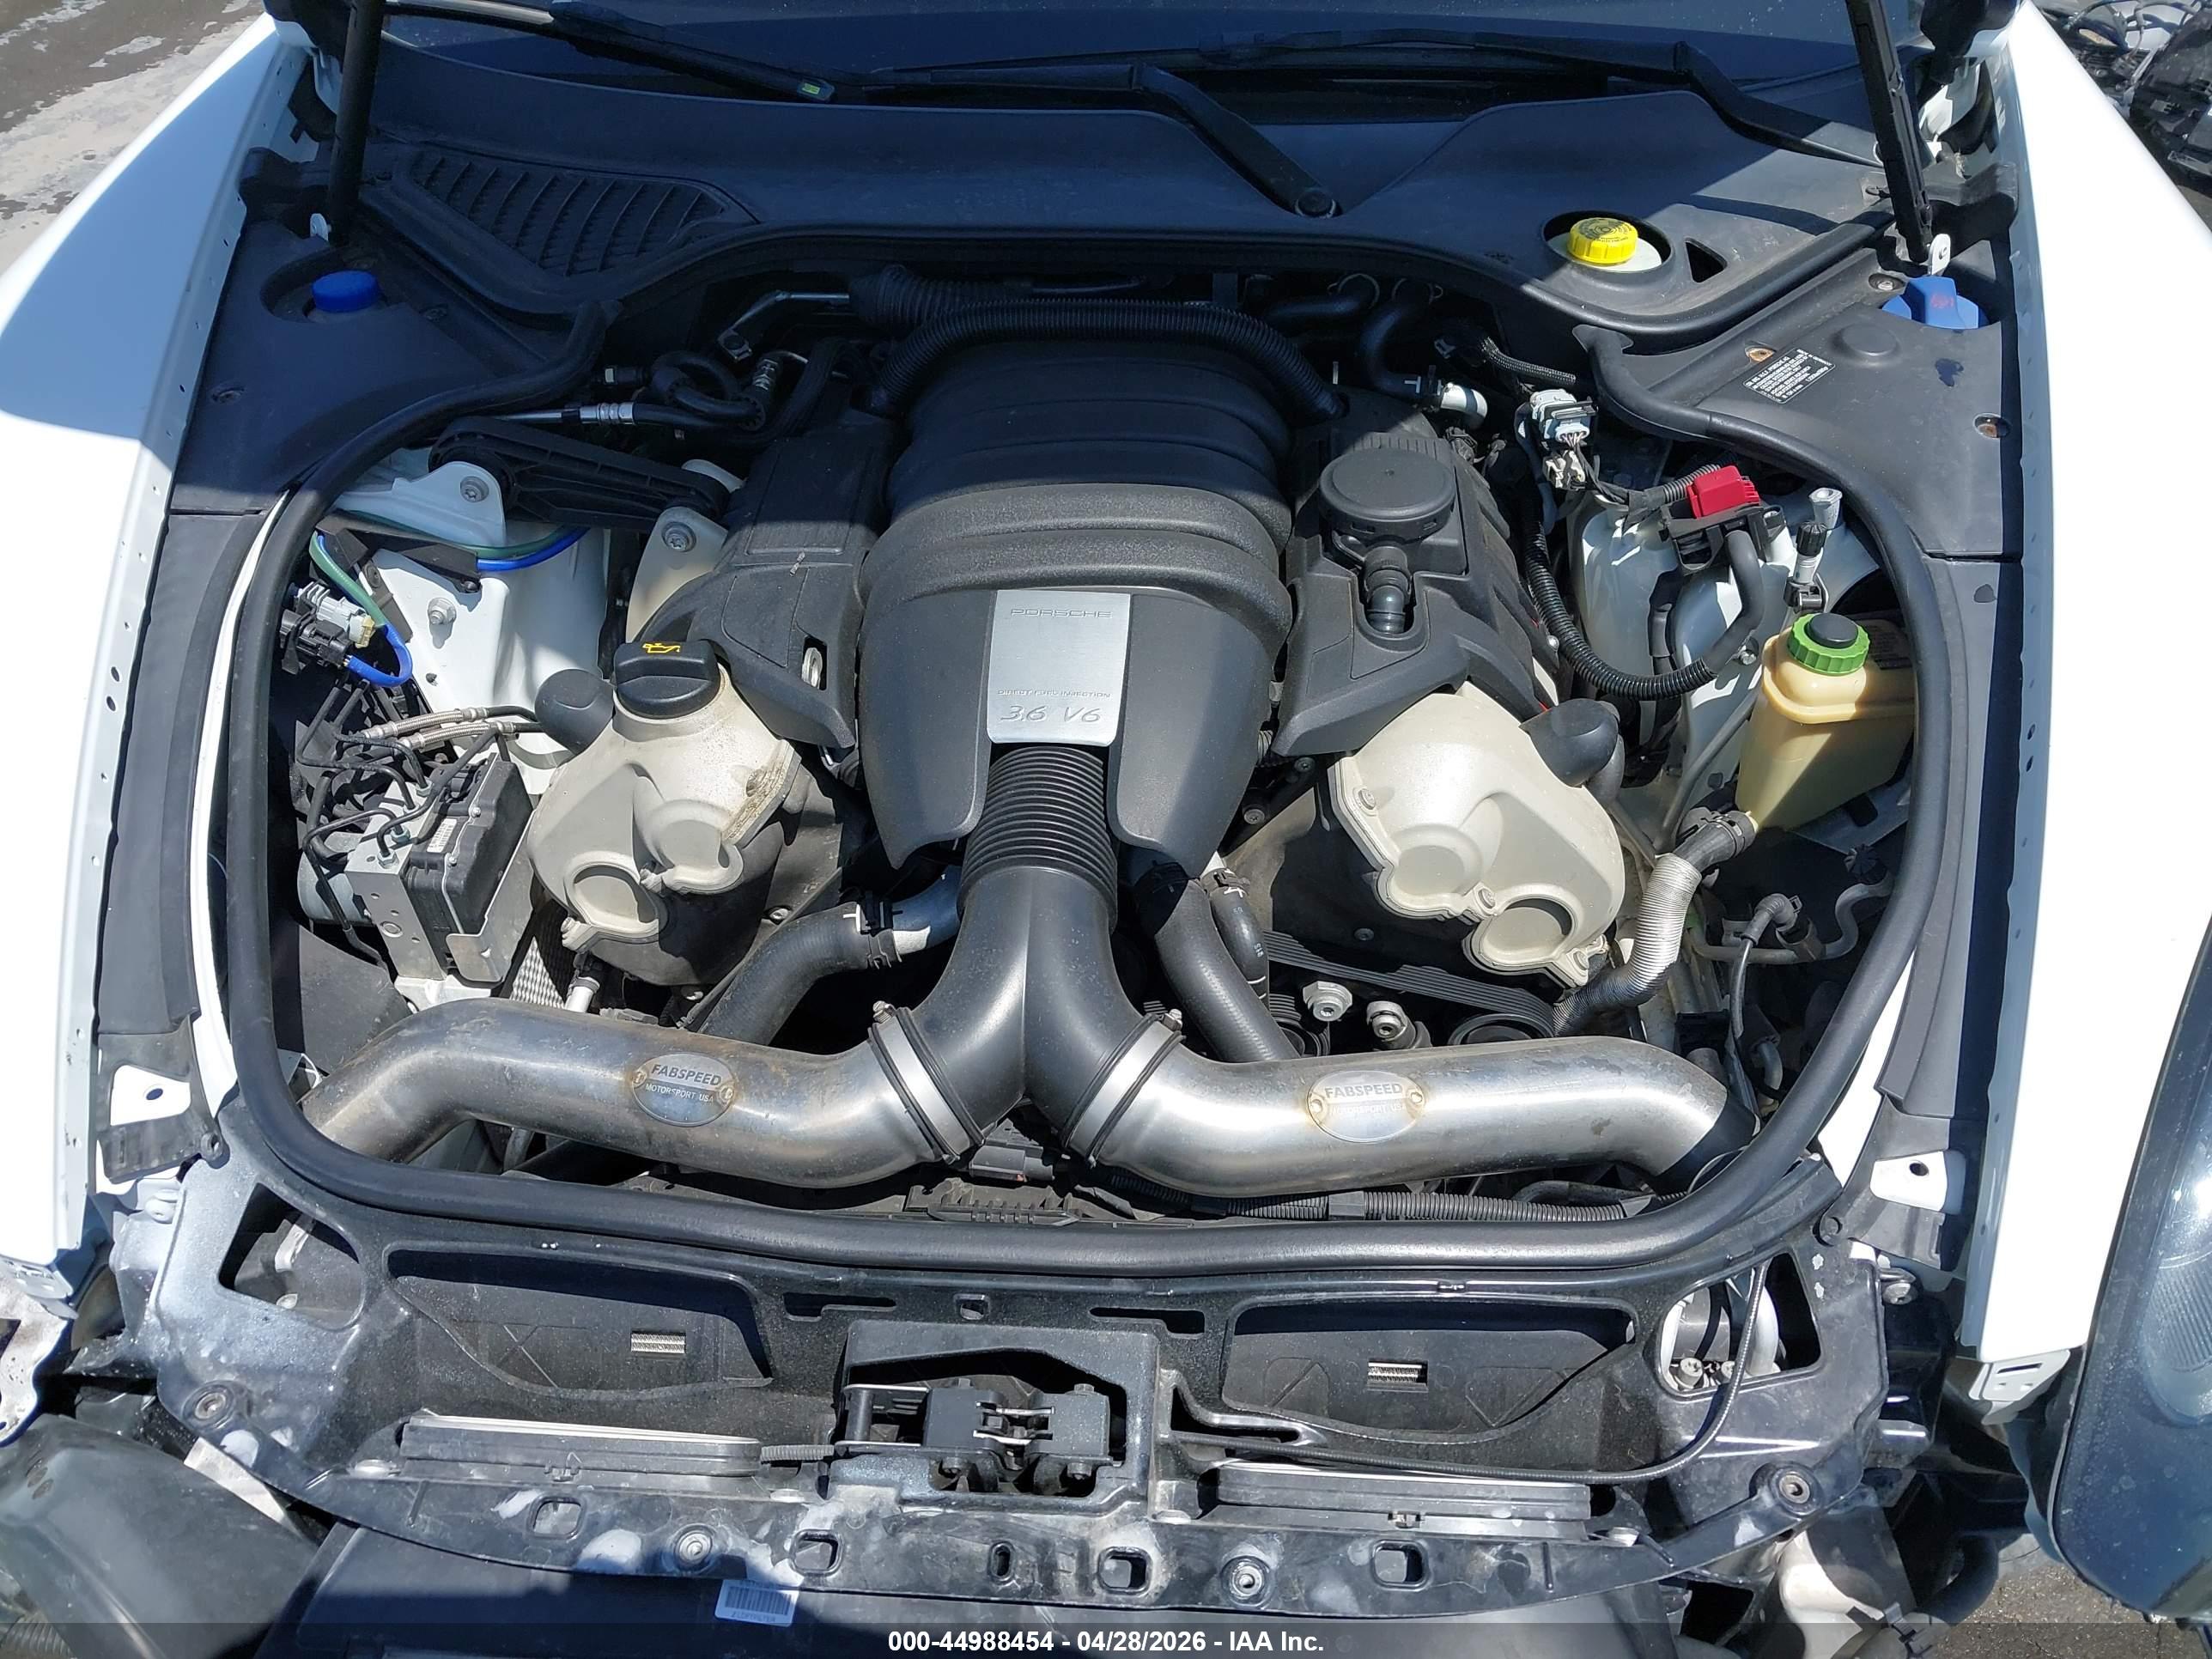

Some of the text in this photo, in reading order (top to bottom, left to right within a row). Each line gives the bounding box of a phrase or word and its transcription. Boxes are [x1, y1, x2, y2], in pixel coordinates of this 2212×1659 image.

[1010, 608, 1113, 619] PORSCHE
[1063, 706, 1102, 722] V6
[651, 1064, 722, 1086] FABSPEED
[645, 1083, 714, 1103] MOTORSPORT USA
[1324, 1083, 1403, 1098] FABSPEED
